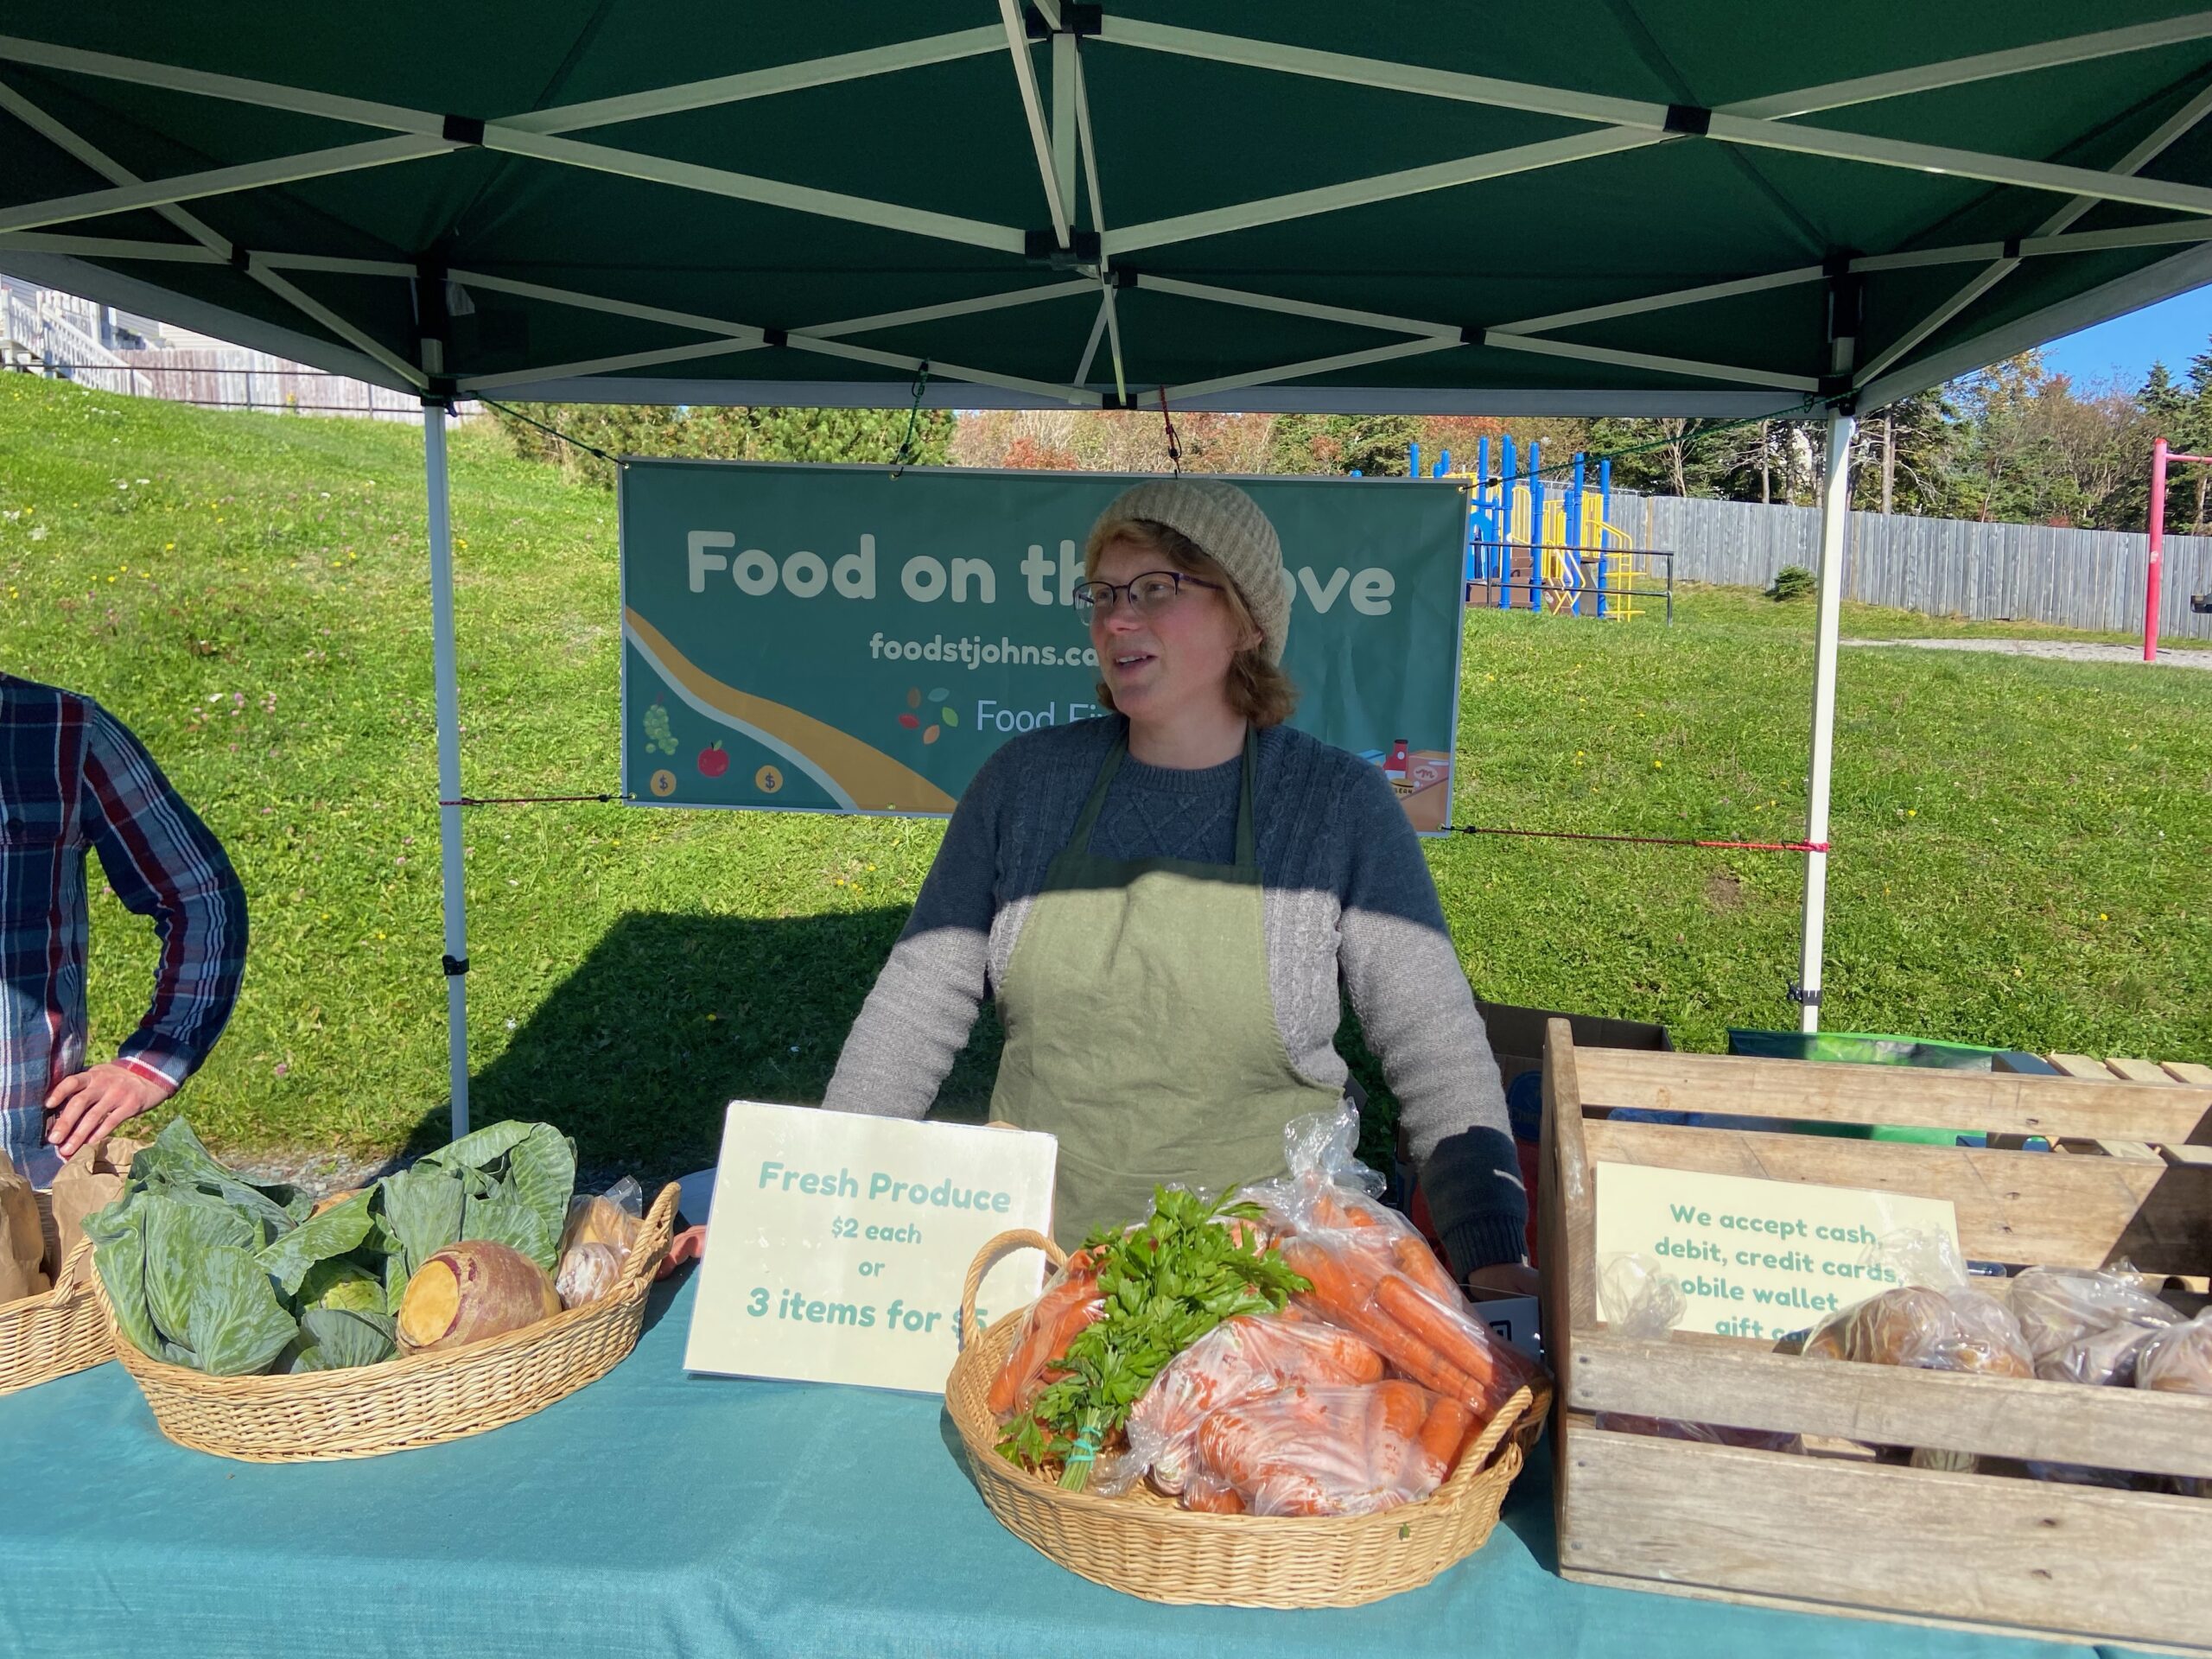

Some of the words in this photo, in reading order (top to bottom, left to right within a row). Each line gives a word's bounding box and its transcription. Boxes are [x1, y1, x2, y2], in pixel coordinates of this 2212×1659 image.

[688, 531, 876, 601] Food
[901, 556, 996, 604] on
[1020, 540, 1086, 606] th
[1281, 567, 1395, 616] ve
[977, 699, 1055, 732] Food
[759, 1161, 858, 1198] Fresh
[868, 1173, 1011, 1213] Produce
[831, 1216, 859, 1239] $2
[865, 1223, 921, 1244] each
[1670, 1204, 1712, 1226] We
[1719, 1213, 1808, 1240] accept
[1815, 1224, 1884, 1249] cash,
[859, 1261, 886, 1277] or
[1655, 1236, 1728, 1266] debit,
[1735, 1250, 1814, 1273] credit
[1822, 1262, 1904, 1287] cards,
[747, 1287, 770, 1318] 3
[779, 1289, 876, 1328] items
[887, 1300, 942, 1332] for
[1662, 1275, 1745, 1301] obile
